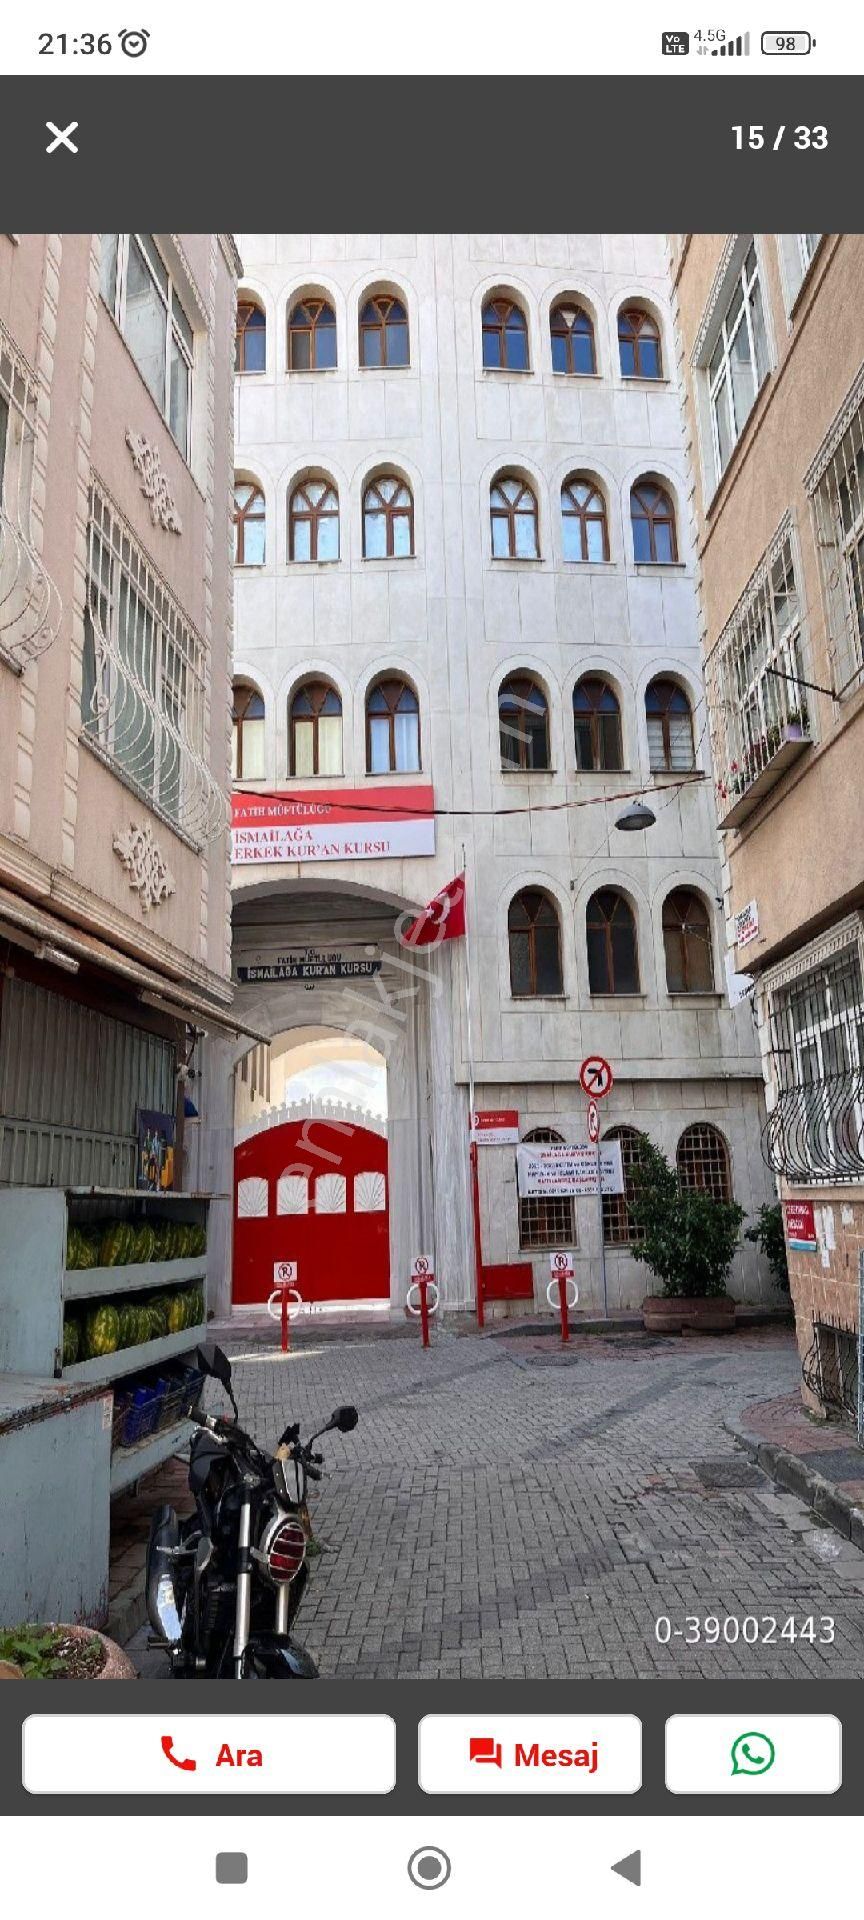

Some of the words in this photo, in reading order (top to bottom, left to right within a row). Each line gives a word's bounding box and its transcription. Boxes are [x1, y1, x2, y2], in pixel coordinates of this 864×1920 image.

[38, 32, 112, 55] 21:36
[693, 29, 727, 42] 4.5G
[775, 37, 796, 51] 98
[665, 44, 685, 54] LTE
[731, 125, 765, 150] 15
[793, 125, 829, 150] 33
[234, 827, 314, 845] İSMAİLAĞA
[234, 845, 283, 861] ERKEK
[344, 841, 391, 855] KURSU
[340, 962, 373, 975] KURSU
[215, 1743, 263, 1767] Ara
[514, 1741, 599, 1774] Mesaj
